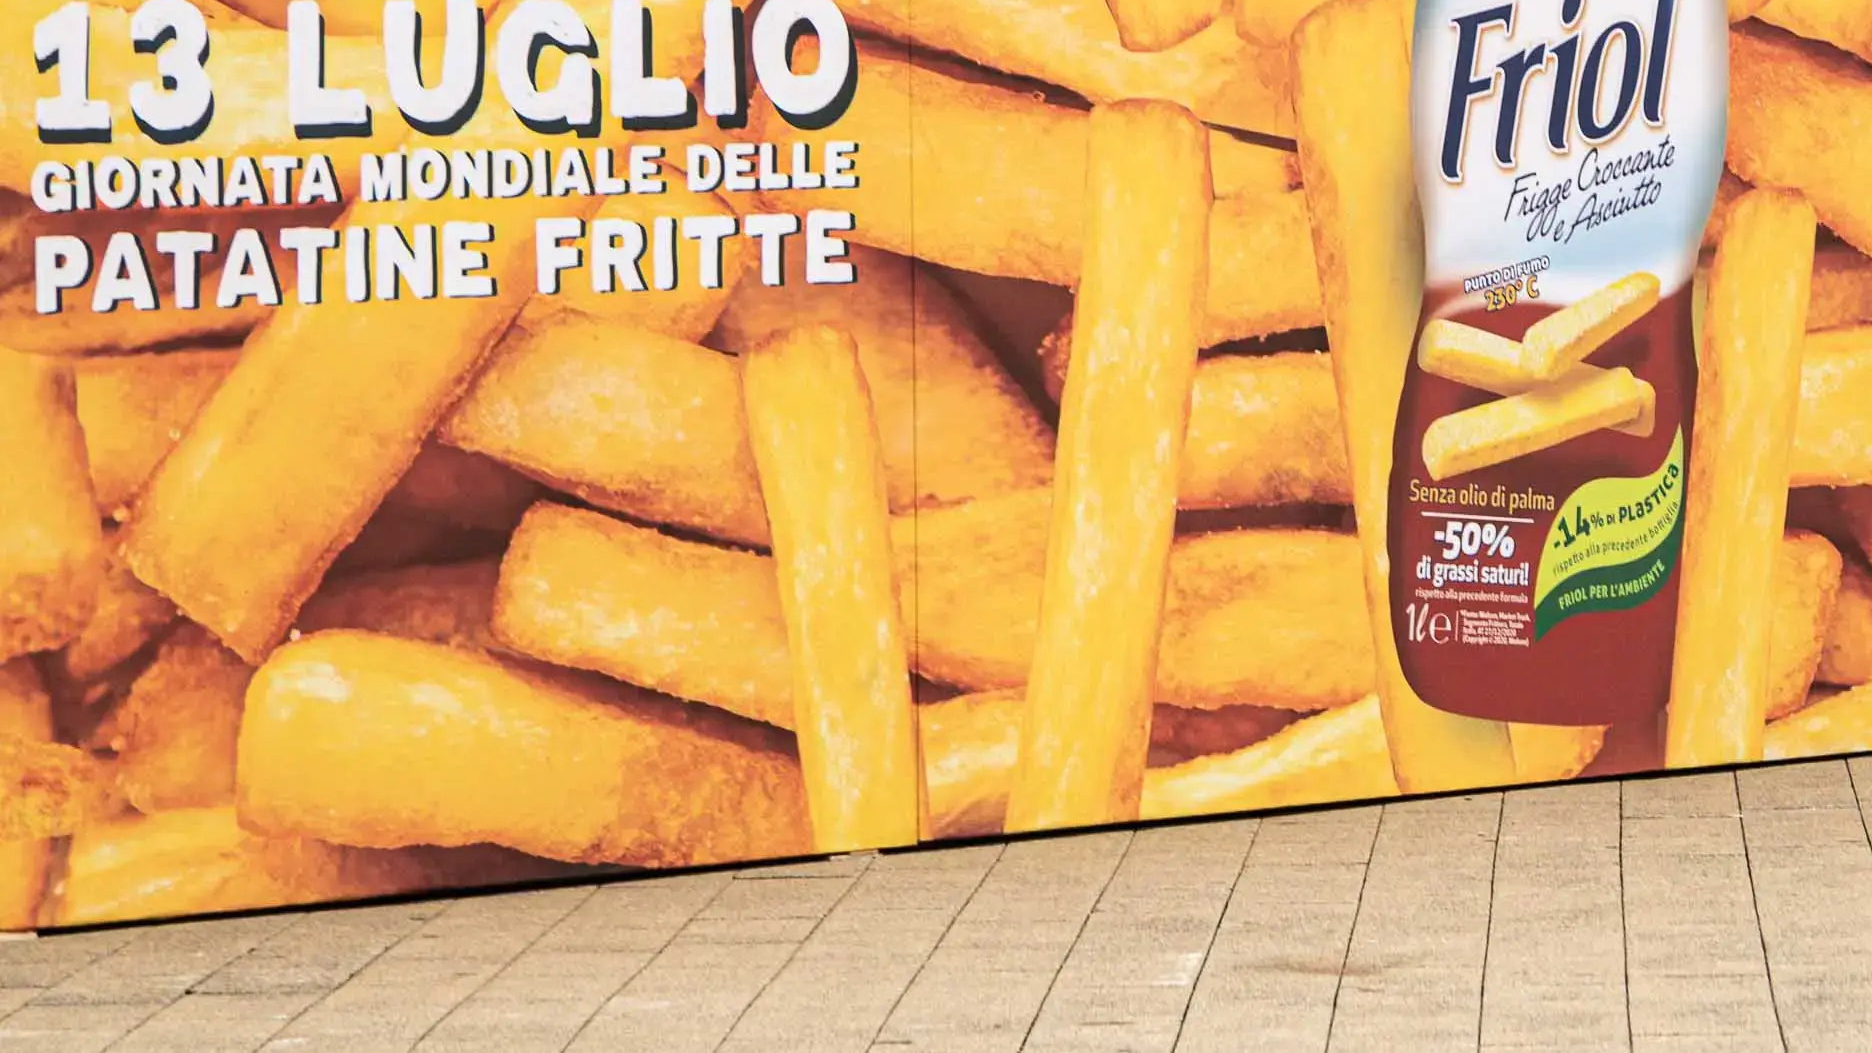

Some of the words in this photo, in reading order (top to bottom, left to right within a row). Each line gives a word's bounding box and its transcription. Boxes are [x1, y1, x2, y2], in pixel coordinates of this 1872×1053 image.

[30, 154, 343, 214] GIORNATA
[361, 143, 668, 204] MONDIALE
[686, 140, 860, 194] DELLE
[1503, 171, 1573, 243] Frigge
[1577, 133, 1676, 192] Croccante
[1553, 219, 1565, 243] e
[1564, 175, 1662, 245] Asciutto
[33, 219, 497, 316] PATATINE
[536, 209, 859, 295] FRITTE
[1502, 265, 1515, 282] DI
[1409, 478, 1456, 504] Senza
[1459, 483, 1488, 507] olio
[1491, 484, 1506, 507] di
[1508, 487, 1556, 515] palma
[1433, 520, 1516, 560] -50%
[1553, 504, 1605, 550] -14%
[1416, 554, 1432, 580] di
[1432, 559, 1479, 588] grassi
[1480, 561, 1530, 587] saturi!
[1558, 587, 1589, 611] FRIOL
[1589, 585, 1608, 599] PER
[1610, 558, 1666, 598] L'AMBIENTE
